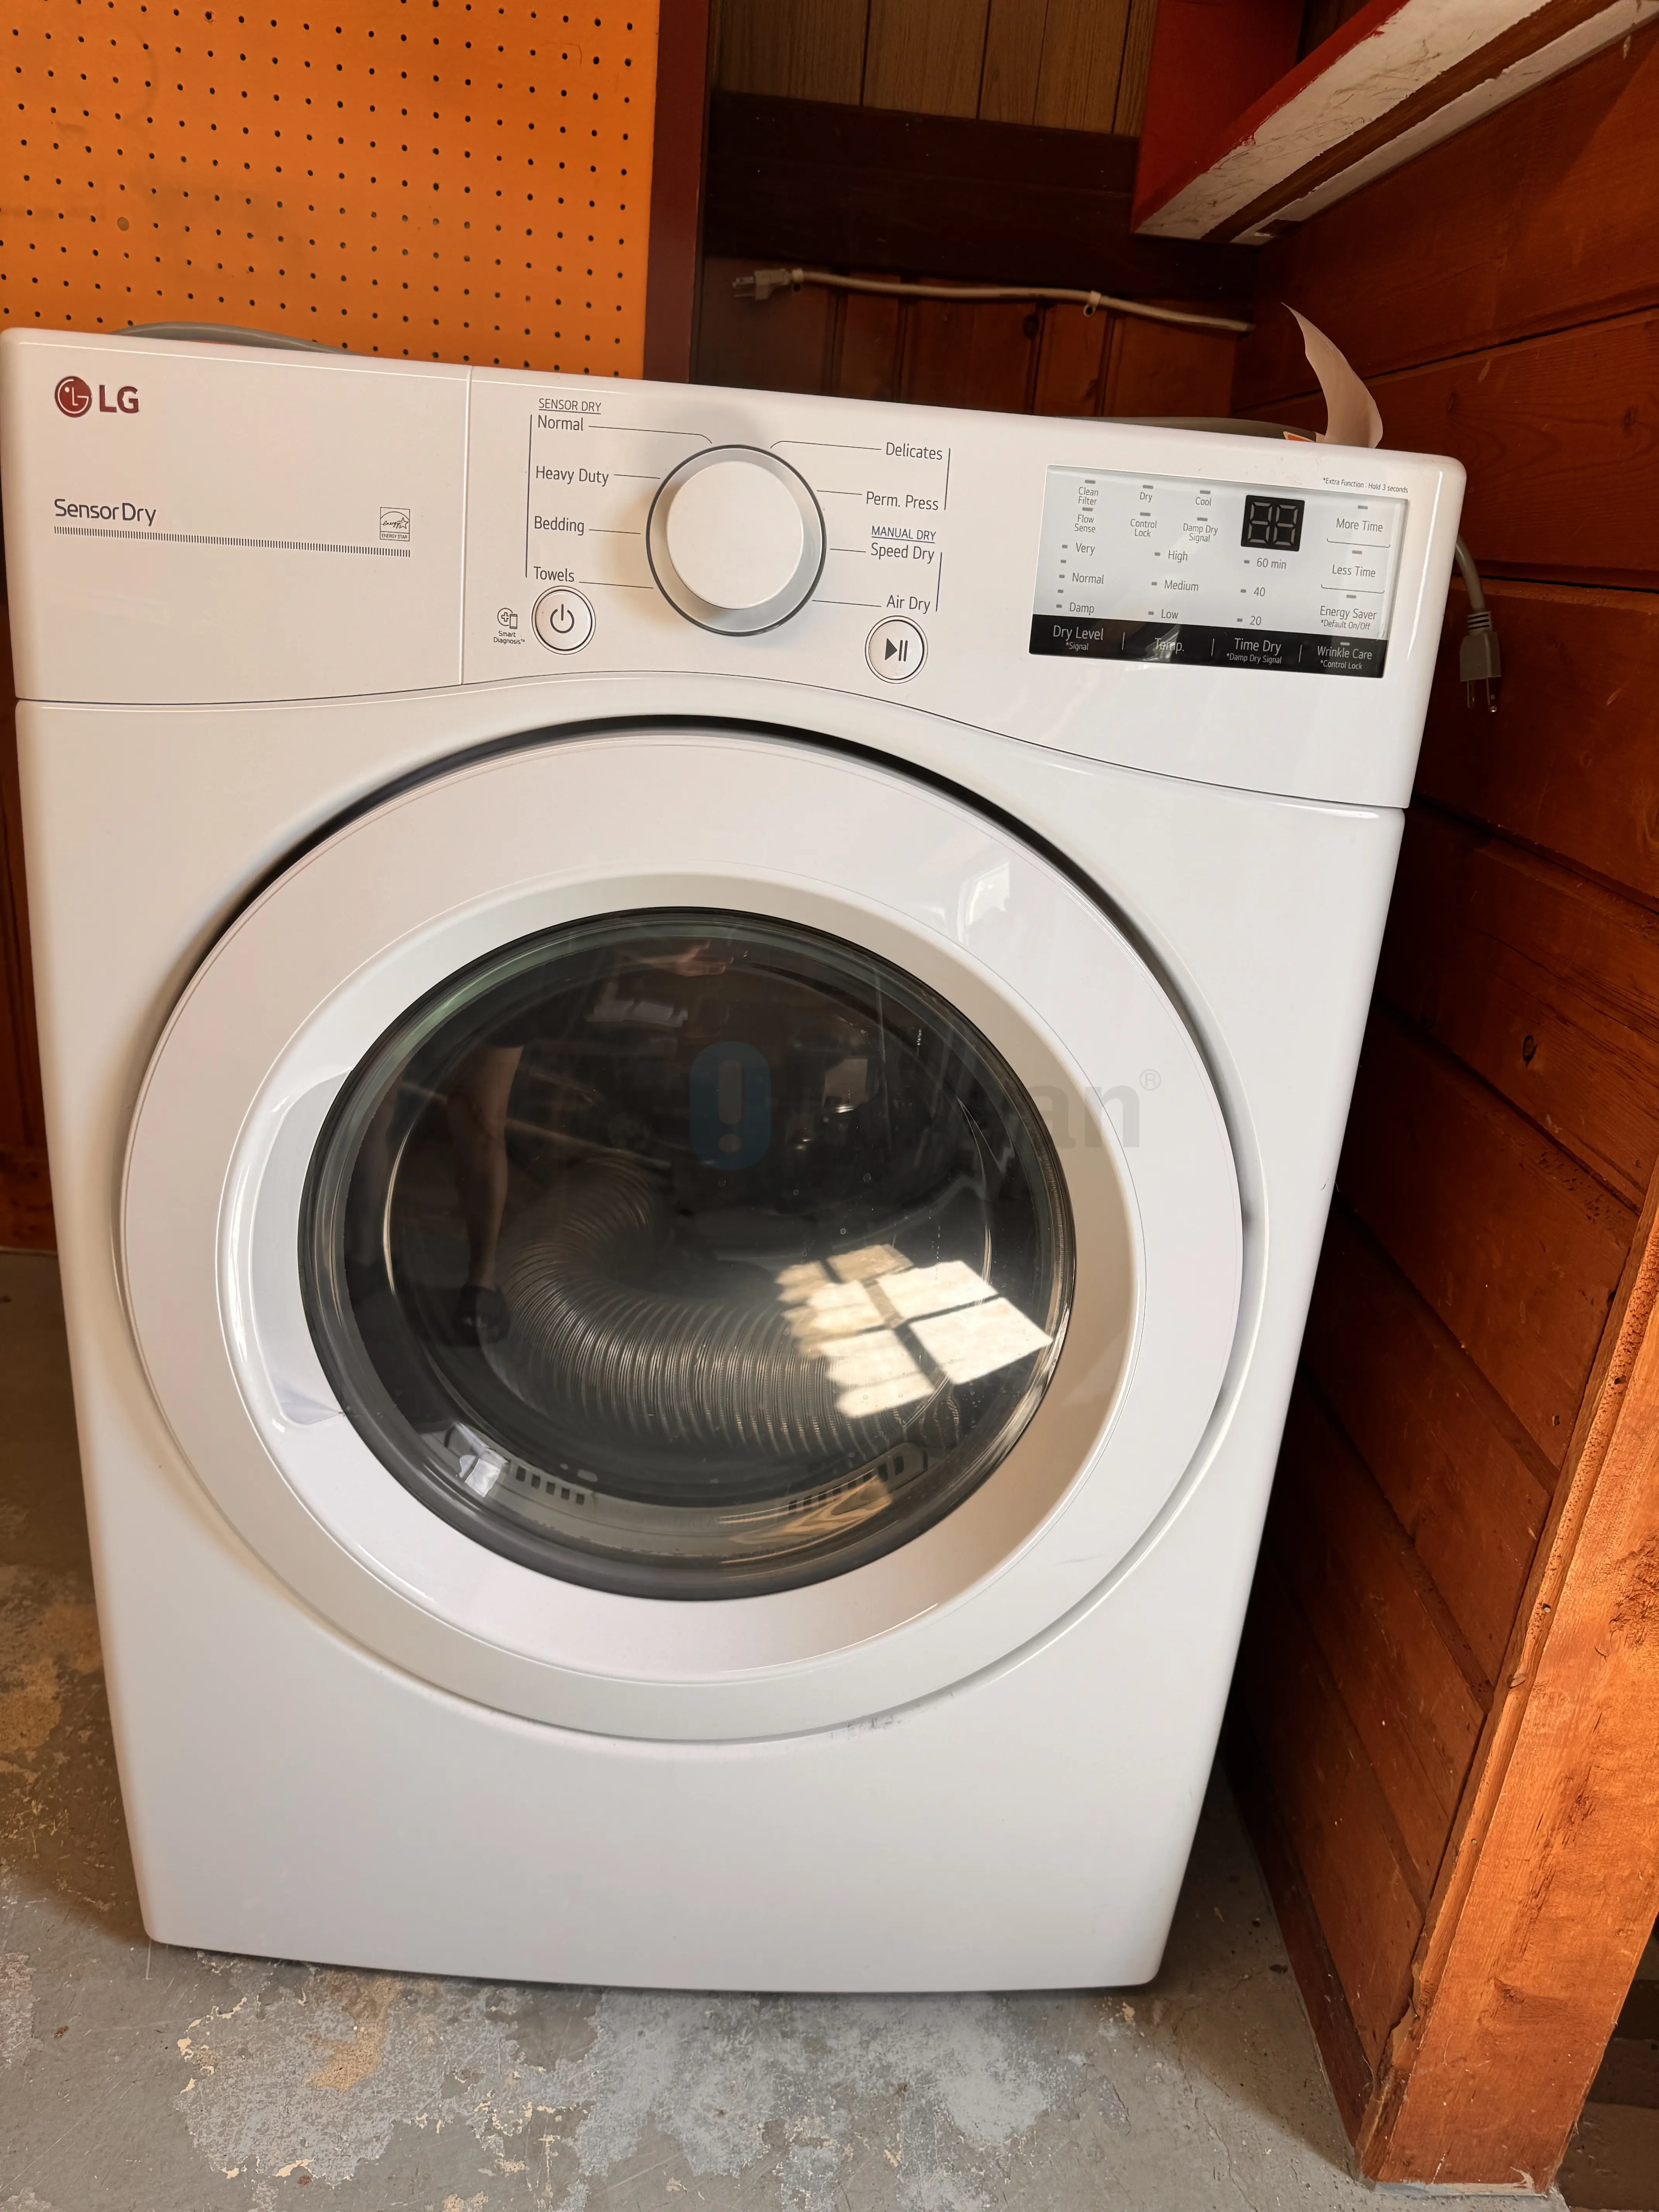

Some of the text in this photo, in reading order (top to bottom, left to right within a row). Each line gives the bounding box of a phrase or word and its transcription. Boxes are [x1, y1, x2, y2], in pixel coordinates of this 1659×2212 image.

[100, 385, 139, 414] LG
[538, 398, 601, 413] SENSOR DRY
[538, 415, 583, 431] Normal
[886, 442, 942, 460] Delicates
[536, 465, 609, 487] Heavy Duty
[1079, 487, 1098, 496] Clean
[1140, 492, 1152, 502] Dry
[867, 491, 938, 510] Perm. Press
[1079, 496, 1097, 505] Filter
[1196, 497, 1211, 506] Cool
[1078, 515, 1094, 523] Flow
[1131, 519, 1157, 528] Control
[1336, 518, 1382, 532] More Time
[535, 516, 584, 536] Bedding
[1075, 524, 1095, 532] Sense
[1183, 523, 1218, 536] Damp Dry
[871, 526, 936, 540] MANUAL DRY
[1135, 529, 1151, 537] Lock
[1189, 533, 1210, 543] Signal
[871, 543, 934, 564] Speed Dry
[1076, 543, 1095, 556] Very
[1168, 550, 1187, 563] High
[1257, 558, 1286, 569] 60 min
[534, 567, 574, 582] Towels
[1333, 564, 1375, 577] Less Time
[1072, 573, 1104, 584] Normal
[1165, 580, 1198, 591] Medium
[1254, 587, 1265, 596] 40
[887, 595, 930, 614] Air Dry
[1070, 602, 1094, 615] Damp
[1161, 609, 1178, 619] Low
[1320, 606, 1377, 620] Energy Saver
[1250, 616, 1261, 625] 20
[1348, 622, 1370, 630] On/Off
[1053, 625, 1103, 641] Dry Level
[1155, 638, 1185, 654] Temp.
[1235, 638, 1281, 656] Time Dry
[1318, 646, 1372, 659] Wrinkle Care
[1250, 654, 1261, 664] Dry
[1262, 655, 1281, 665] Signal
